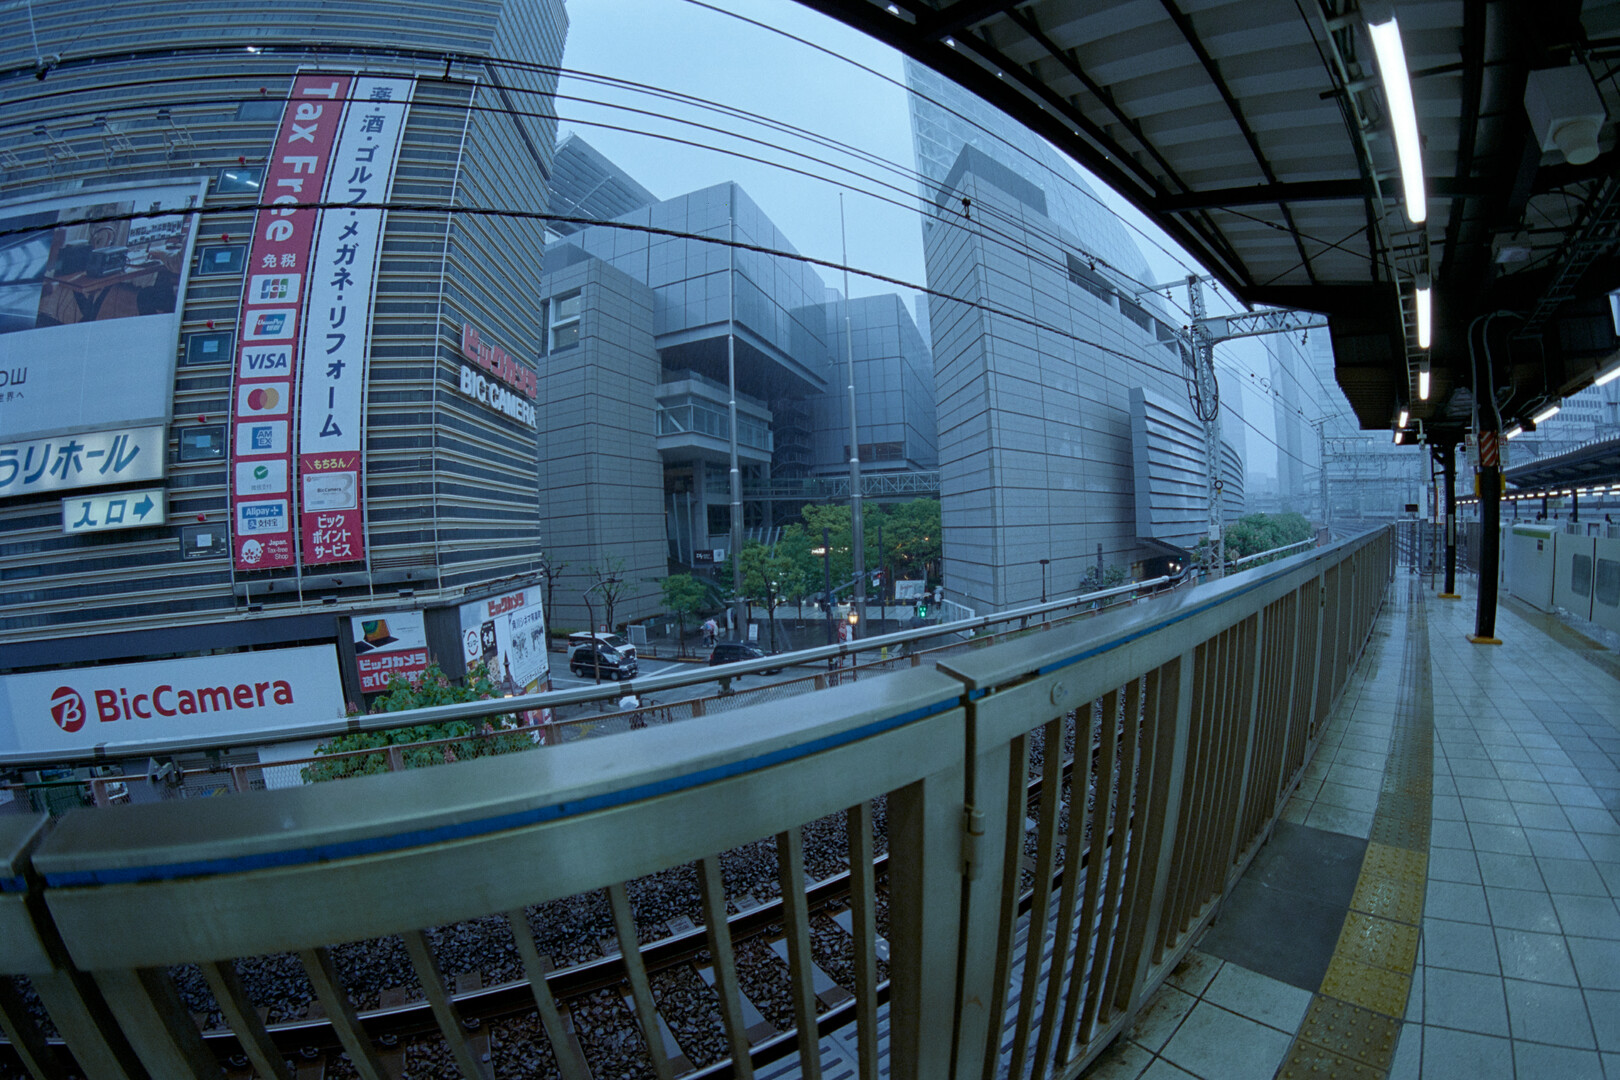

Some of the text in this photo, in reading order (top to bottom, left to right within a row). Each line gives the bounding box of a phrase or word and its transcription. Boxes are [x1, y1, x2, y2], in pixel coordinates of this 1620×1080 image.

[266, 82, 339, 242] Tax Free
[261, 253, 296, 268] 免税
[260, 284, 287, 293] JCB
[245, 353, 287, 370] VISA
[460, 365, 537, 429] BIC CAMERA
[313, 458, 346, 470] もちろん
[73, 500, 127, 528] 入口
[317, 514, 345, 528] ビック
[312, 529, 351, 544] ポイント
[274, 552, 289, 561] Shop
[314, 543, 352, 559] サービス
[359, 653, 427, 671] ビックカメラ
[94, 680, 294, 722] BicCamera
